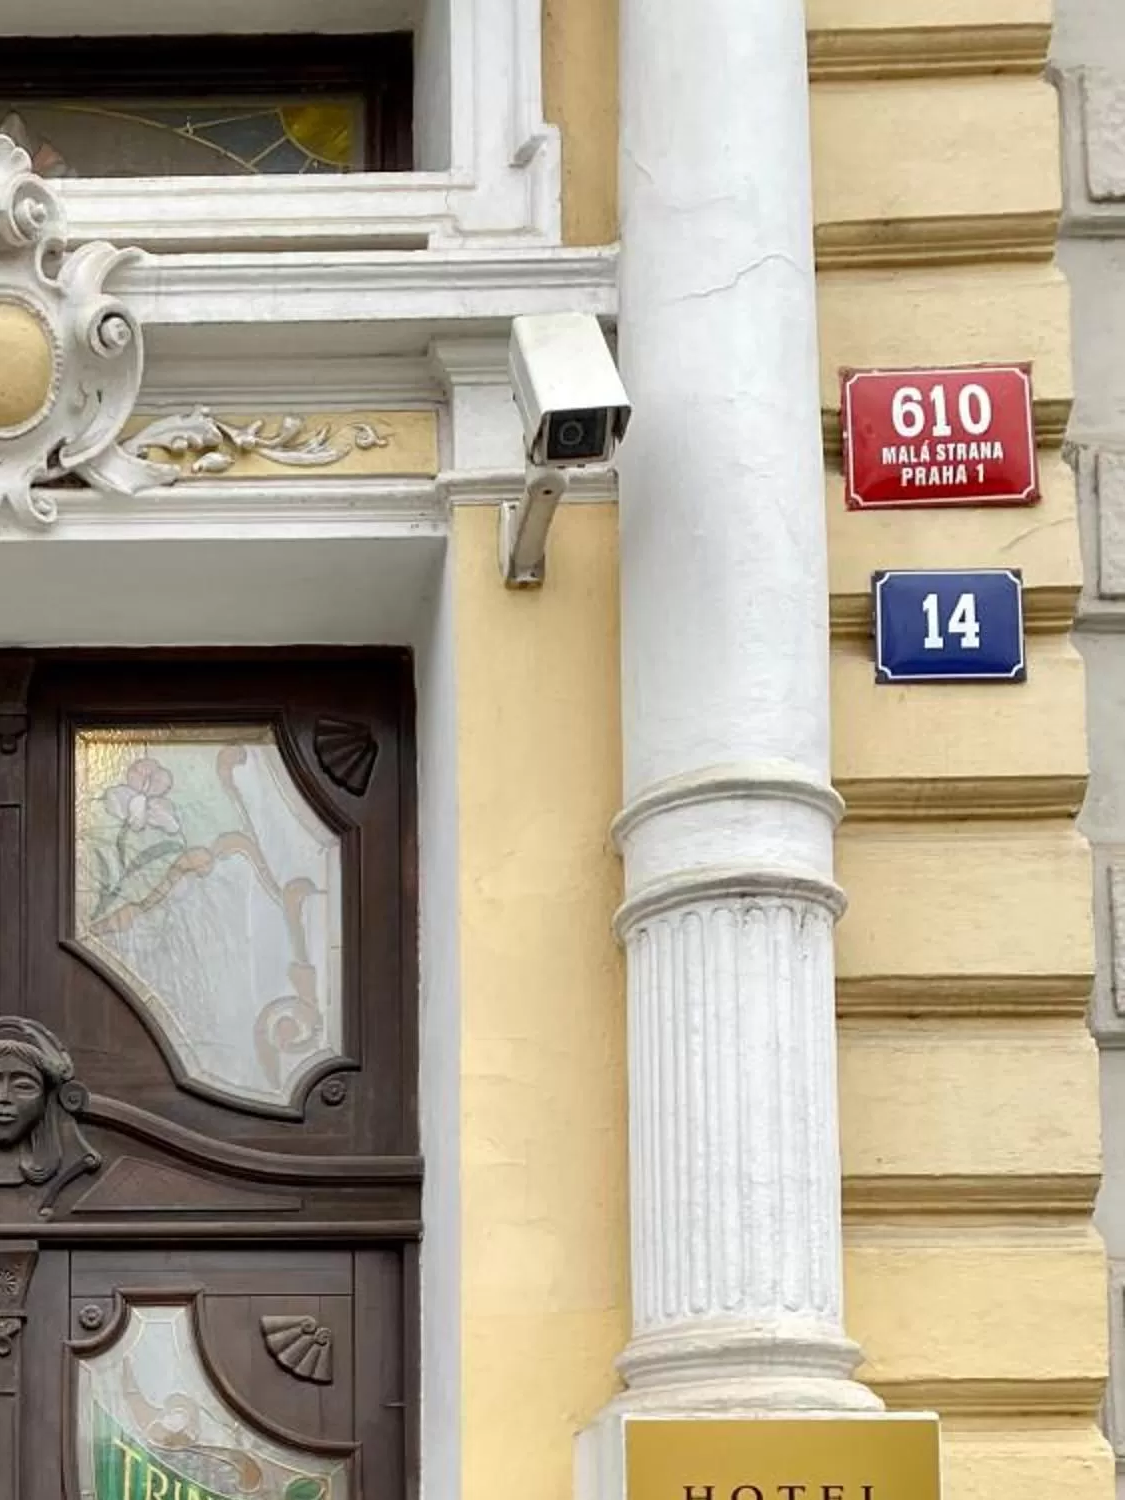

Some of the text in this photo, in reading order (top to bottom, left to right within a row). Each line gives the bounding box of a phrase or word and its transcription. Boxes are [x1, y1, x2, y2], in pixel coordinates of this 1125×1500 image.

[892, 383, 992, 437] 610
[881, 439, 1004, 465] MALÁ STRANA
[900, 462, 985, 487] PRAHA 1
[922, 593, 980, 649] 14
